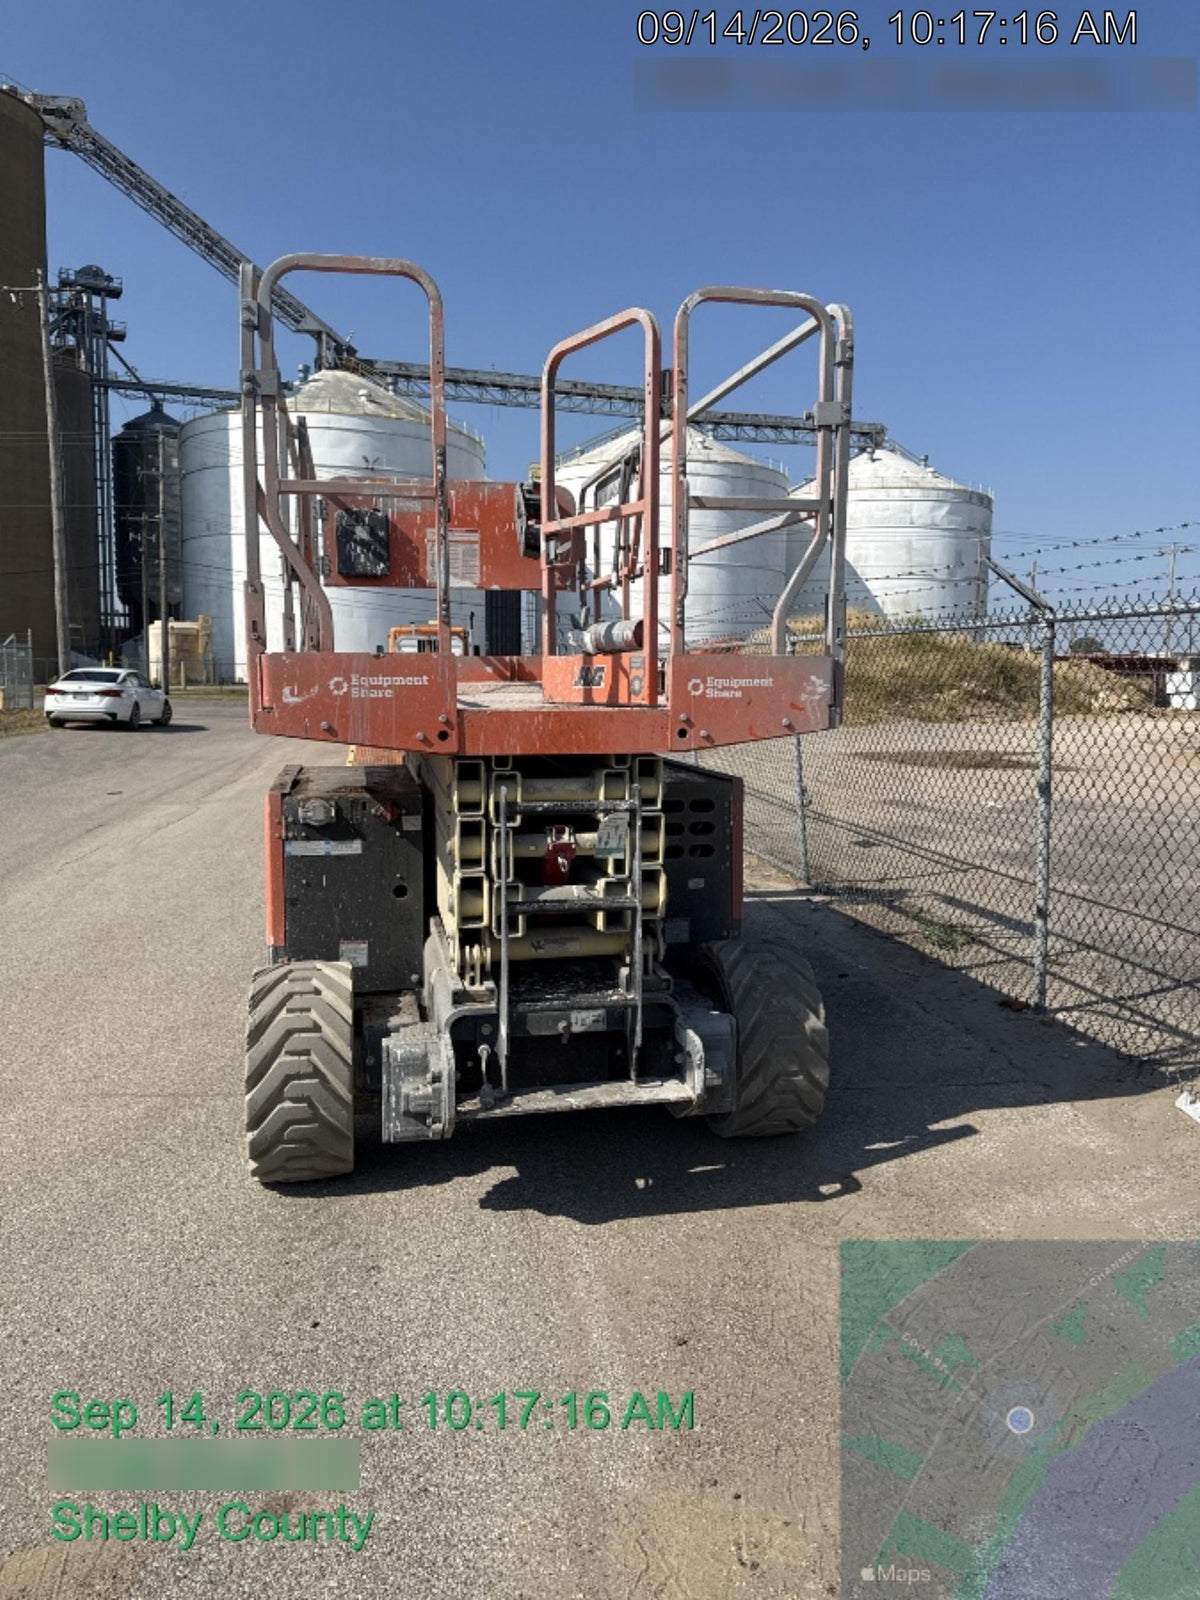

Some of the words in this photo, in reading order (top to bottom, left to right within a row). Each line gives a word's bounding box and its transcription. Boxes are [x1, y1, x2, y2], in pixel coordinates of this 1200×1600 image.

[351, 674, 429, 687] Equipment
[706, 677, 774, 688] Equipment
[351, 688, 393, 698] Share
[705, 688, 743, 698] Share
